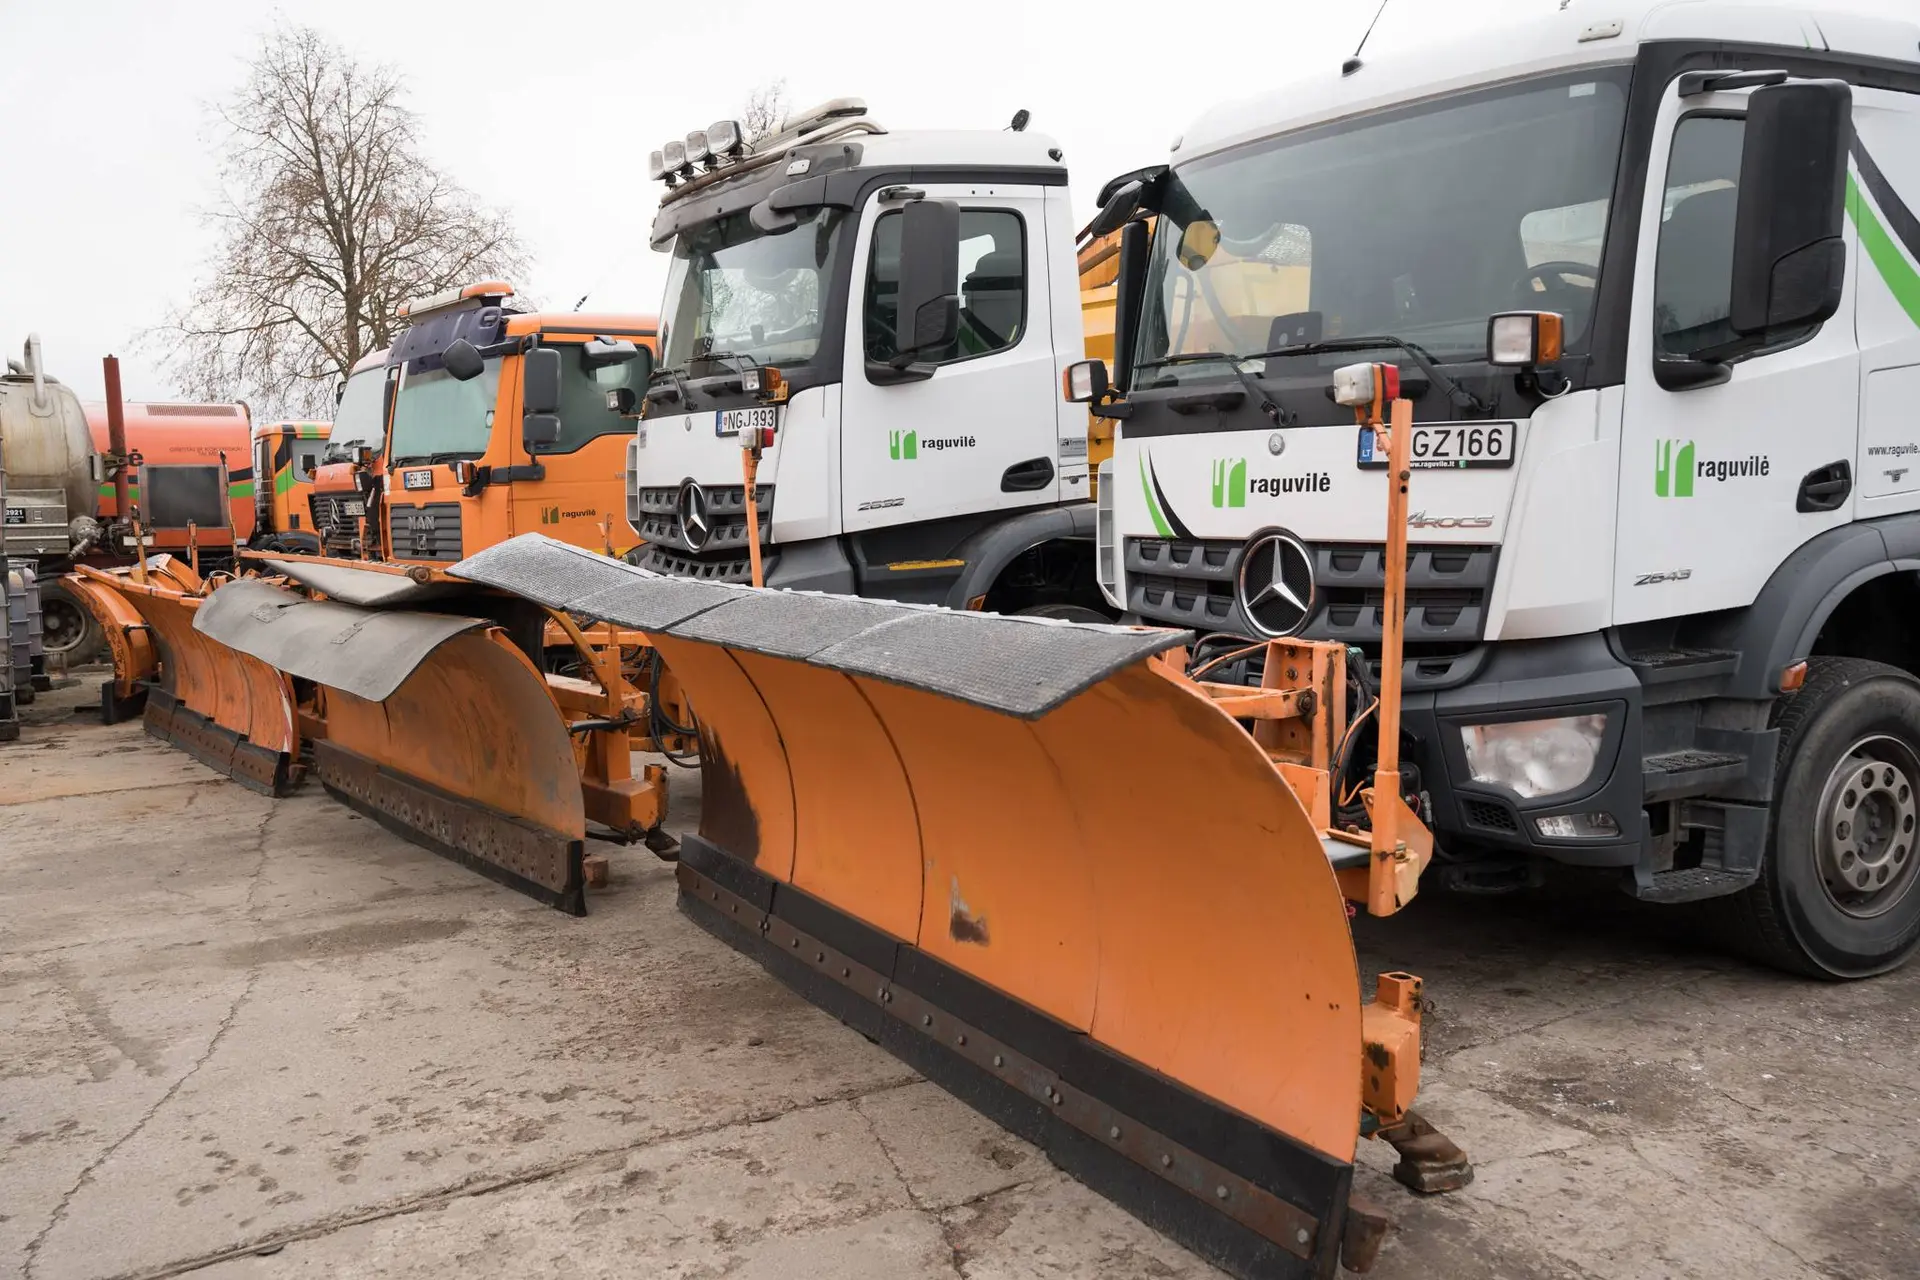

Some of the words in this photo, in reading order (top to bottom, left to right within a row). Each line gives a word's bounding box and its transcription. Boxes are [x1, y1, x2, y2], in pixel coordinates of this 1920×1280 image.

[728, 409, 775, 430] NGJ393
[921, 435, 976, 450] raguvilė
[1412, 428, 1503, 457] GZ166
[1697, 455, 1770, 482] raguvilė
[1250, 472, 1331, 497] raguvilė
[408, 516, 436, 530] MAN
